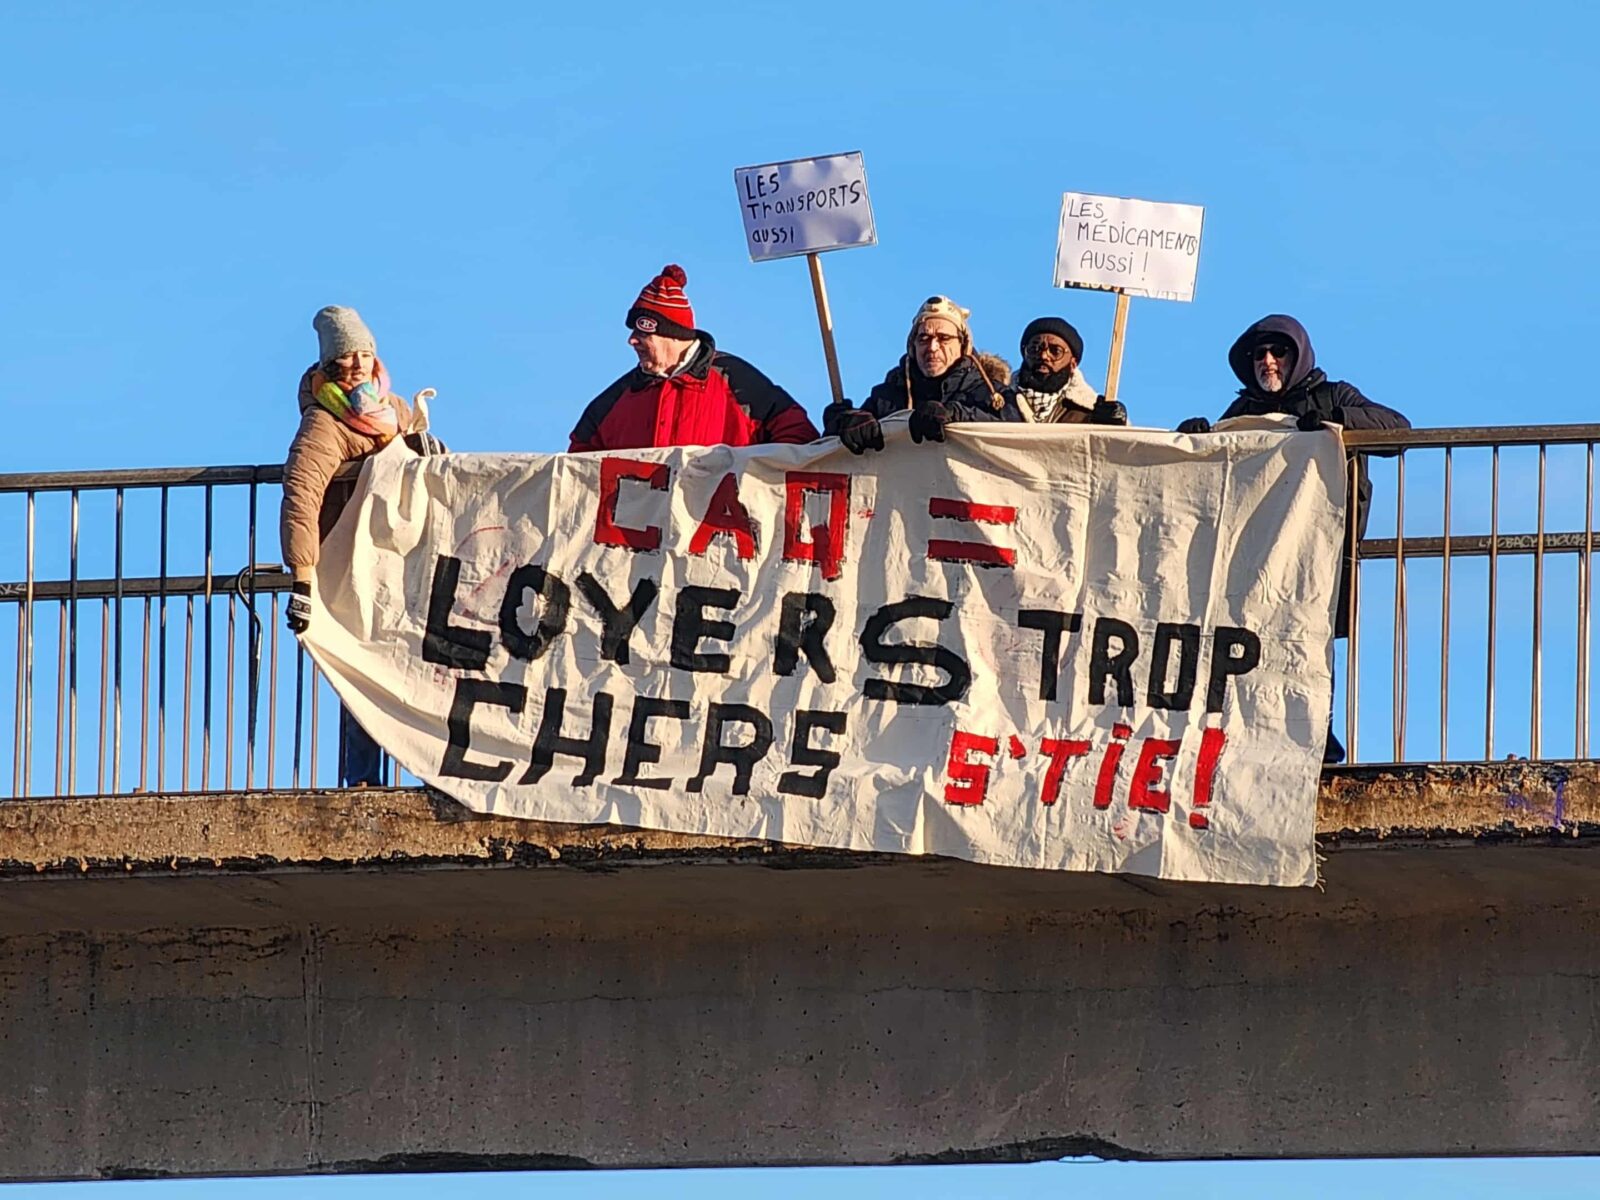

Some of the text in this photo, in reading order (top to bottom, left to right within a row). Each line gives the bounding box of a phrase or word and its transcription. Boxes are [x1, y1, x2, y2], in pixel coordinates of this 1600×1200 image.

[745, 172, 780, 200] LES
[1068, 198, 1105, 219] LES
[422, 553, 1262, 713] LOYERS TROP
[438, 676, 848, 800] CHERS
